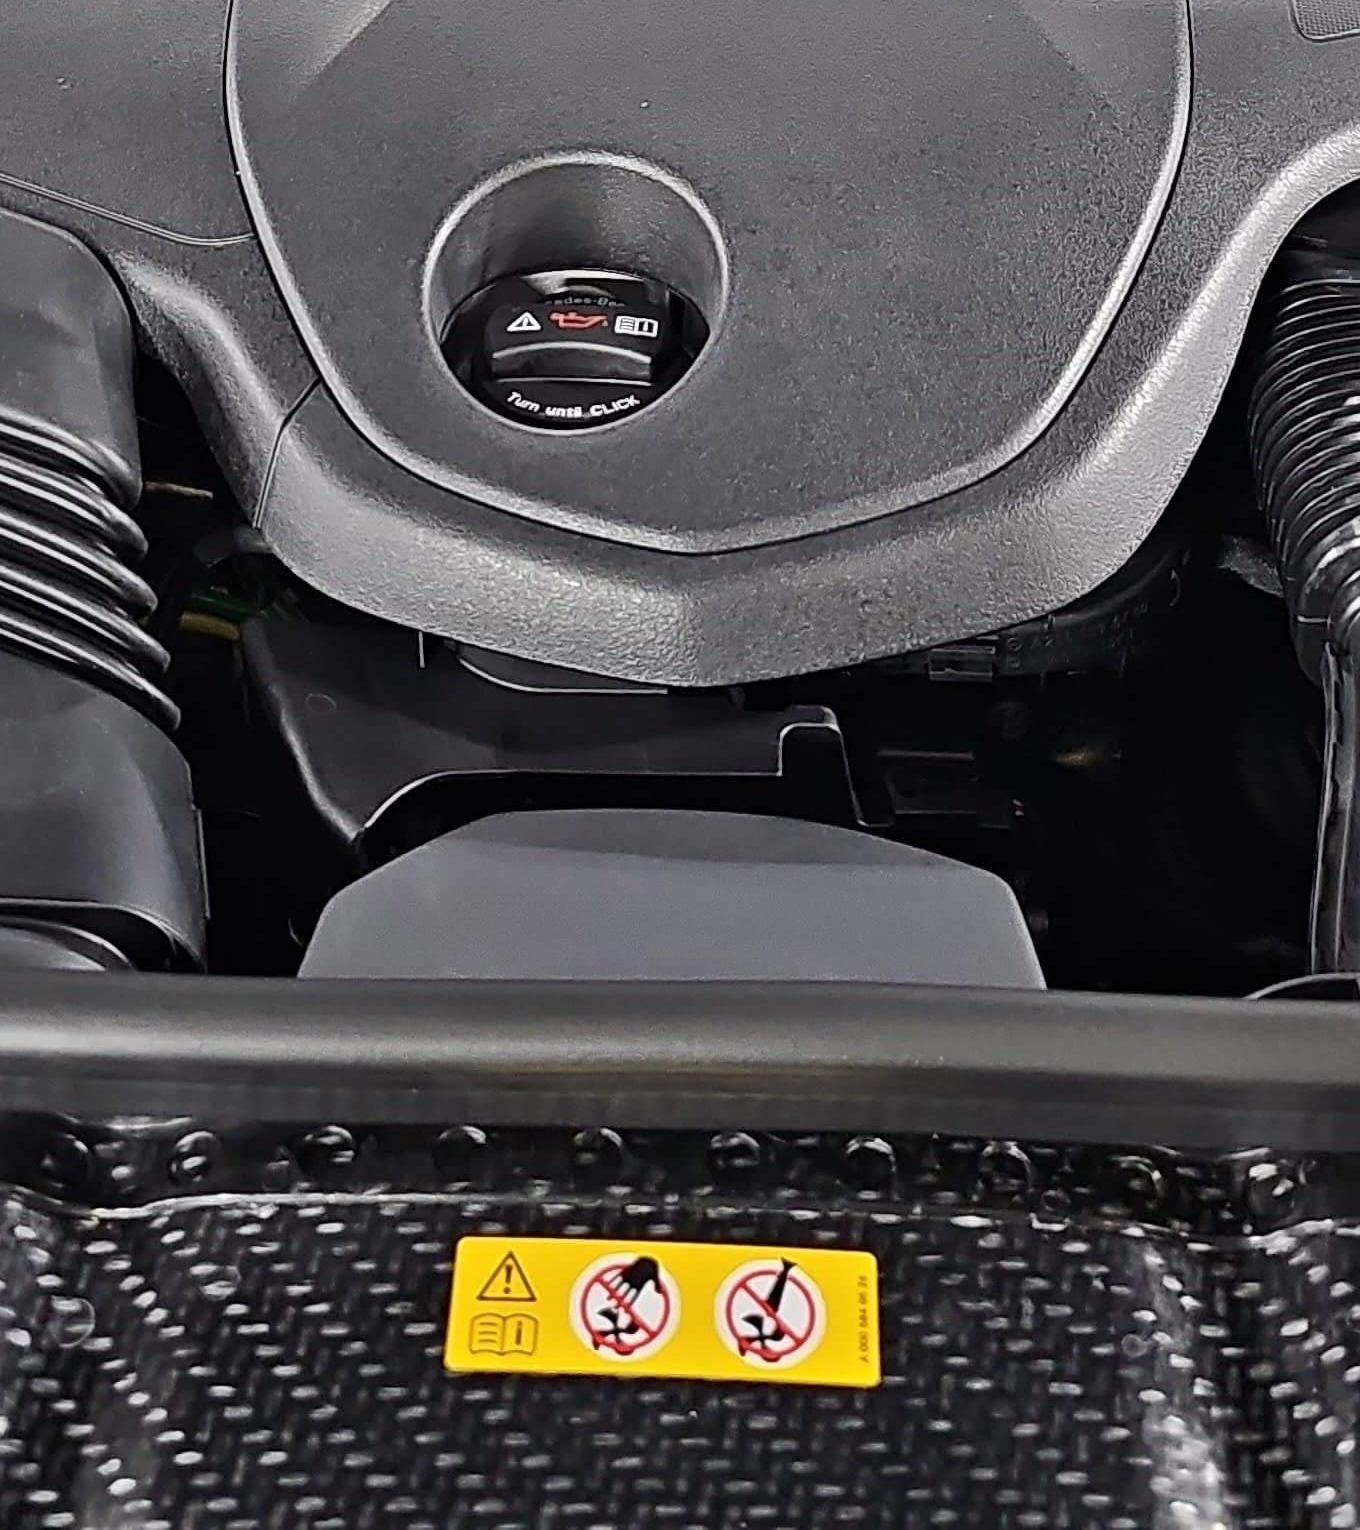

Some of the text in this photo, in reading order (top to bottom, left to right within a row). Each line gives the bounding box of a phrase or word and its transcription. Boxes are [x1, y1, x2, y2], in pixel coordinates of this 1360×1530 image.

[506, 391, 641, 418] Turn until CLICK
